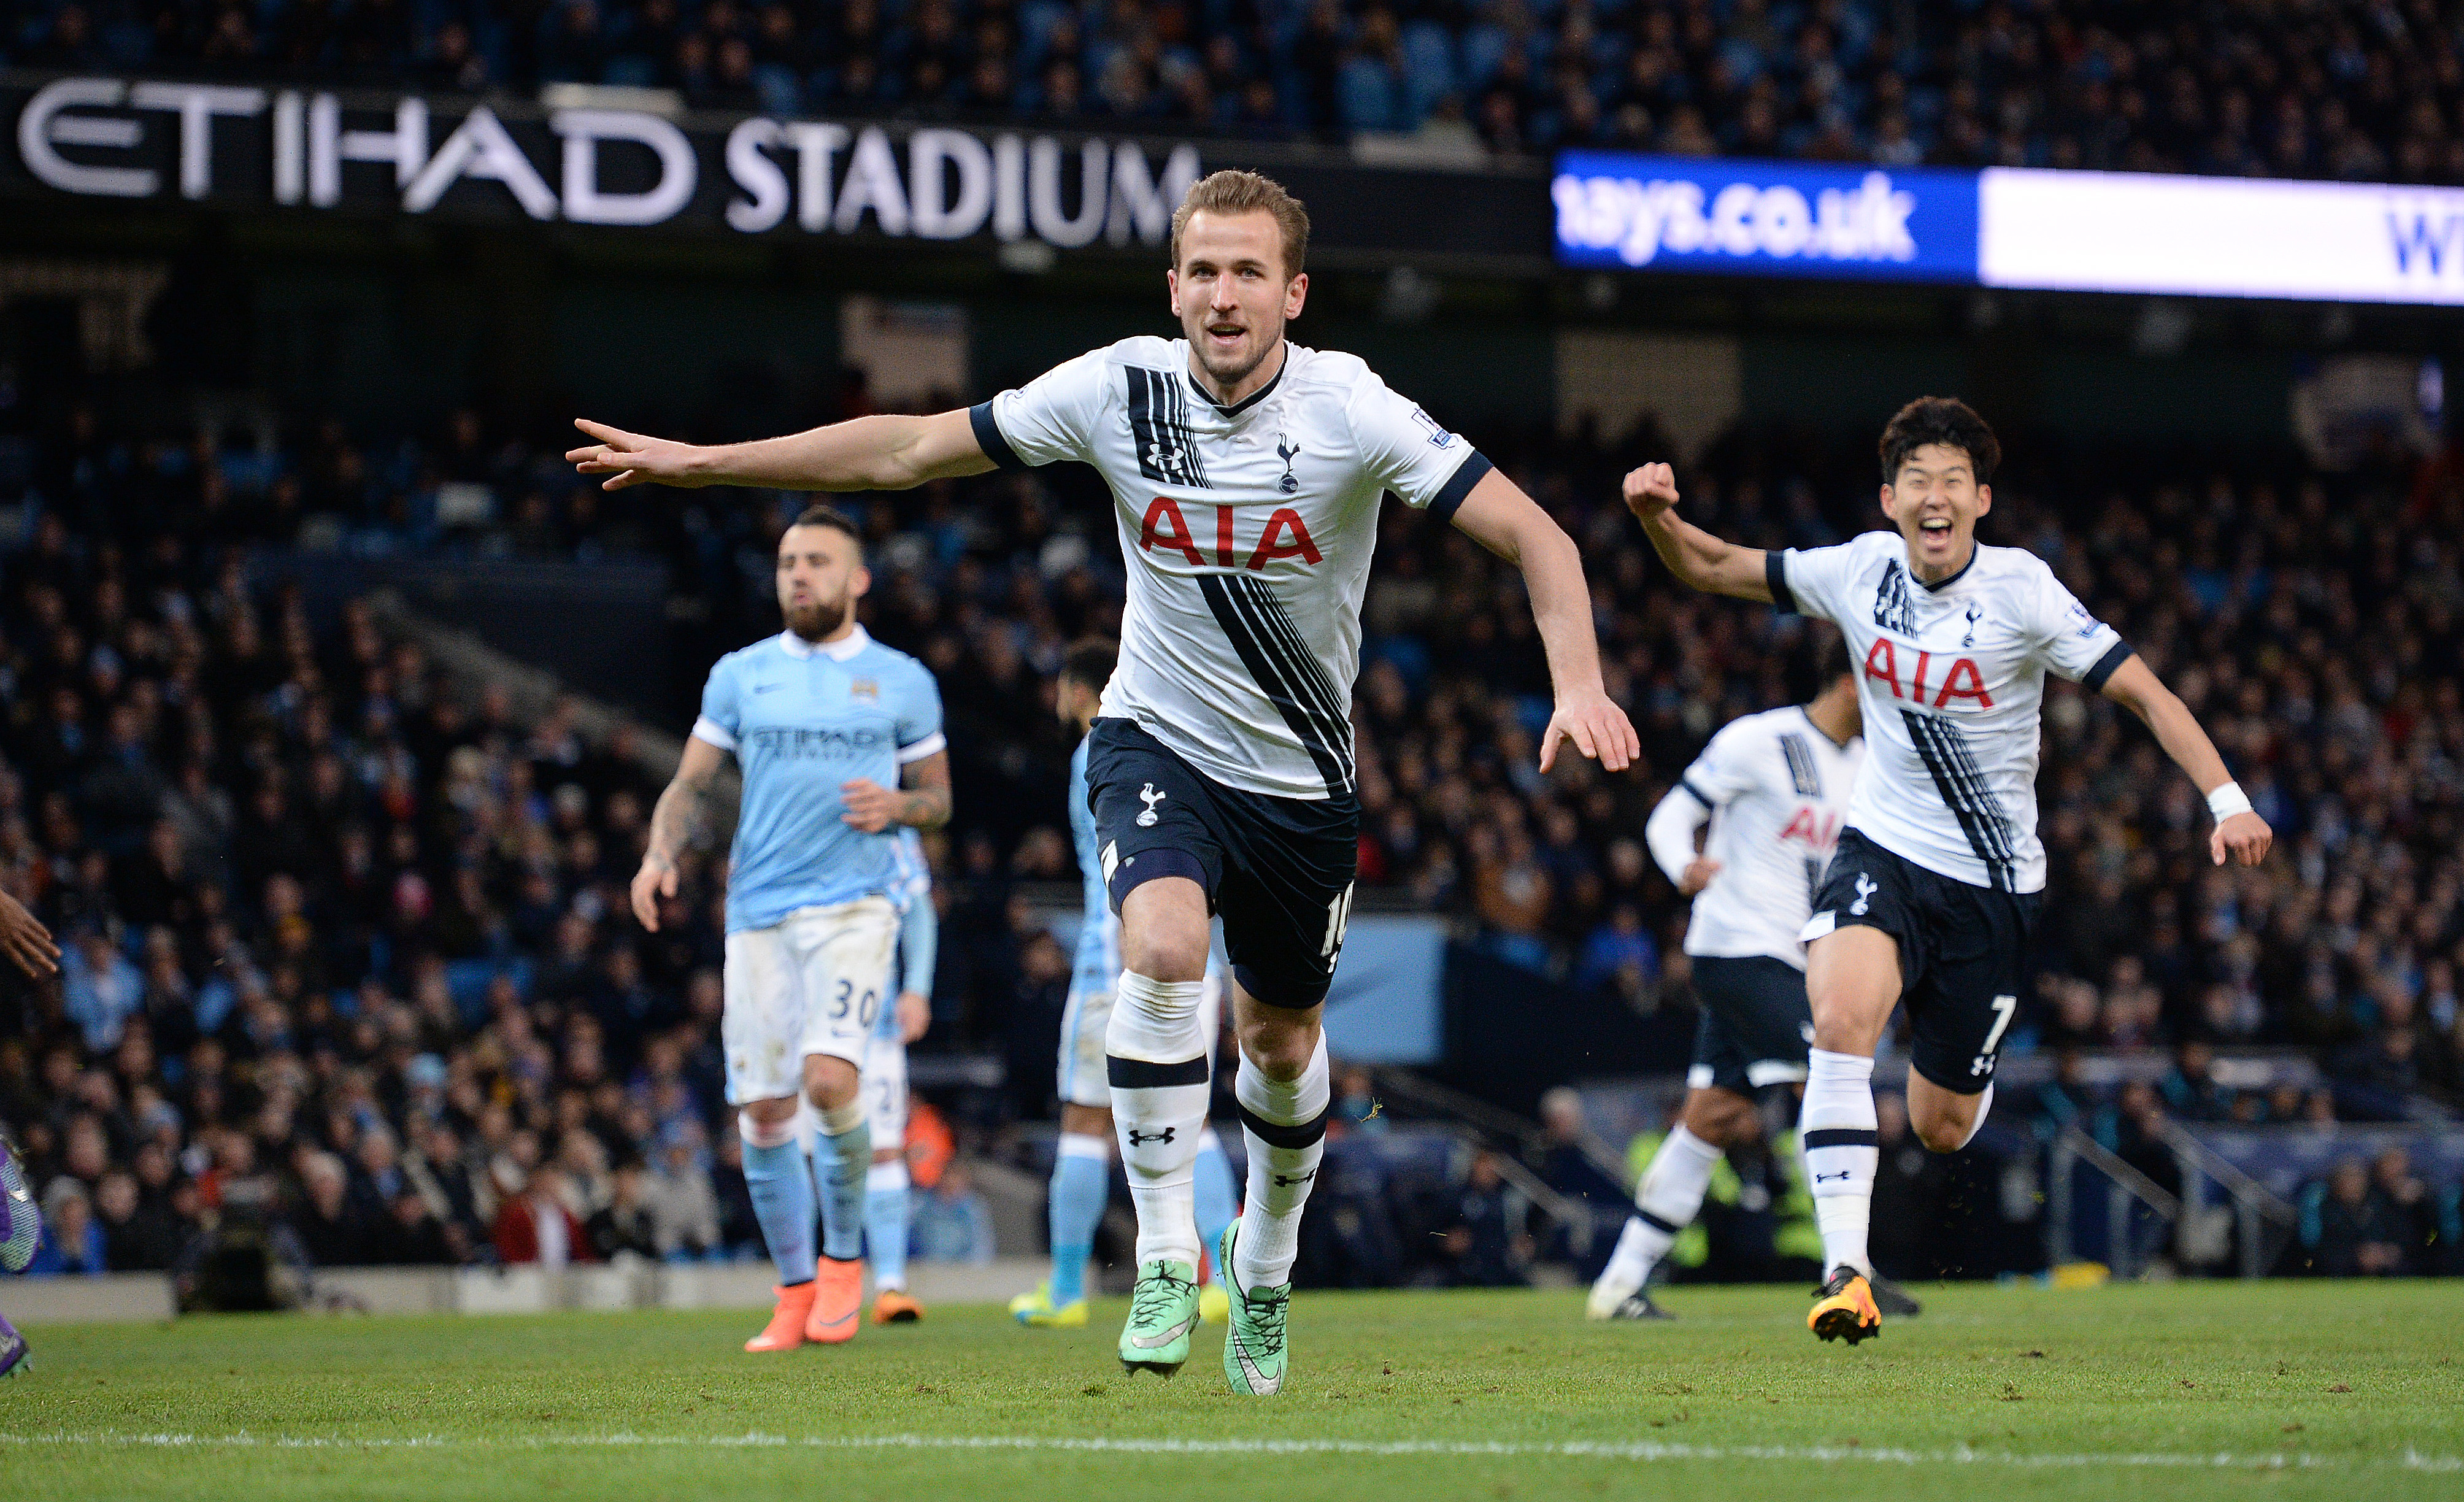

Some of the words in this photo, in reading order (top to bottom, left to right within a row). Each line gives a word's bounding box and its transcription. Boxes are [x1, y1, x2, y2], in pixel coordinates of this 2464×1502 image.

[17, 77, 699, 225] ETIHAD
[725, 117, 1204, 246] STADIUM
[1139, 496, 1323, 571] AIA
[1866, 637, 1995, 711] AIA
[1781, 805, 1840, 850] AI
[828, 978, 878, 1028] 30
[1981, 994, 2017, 1054] 7
